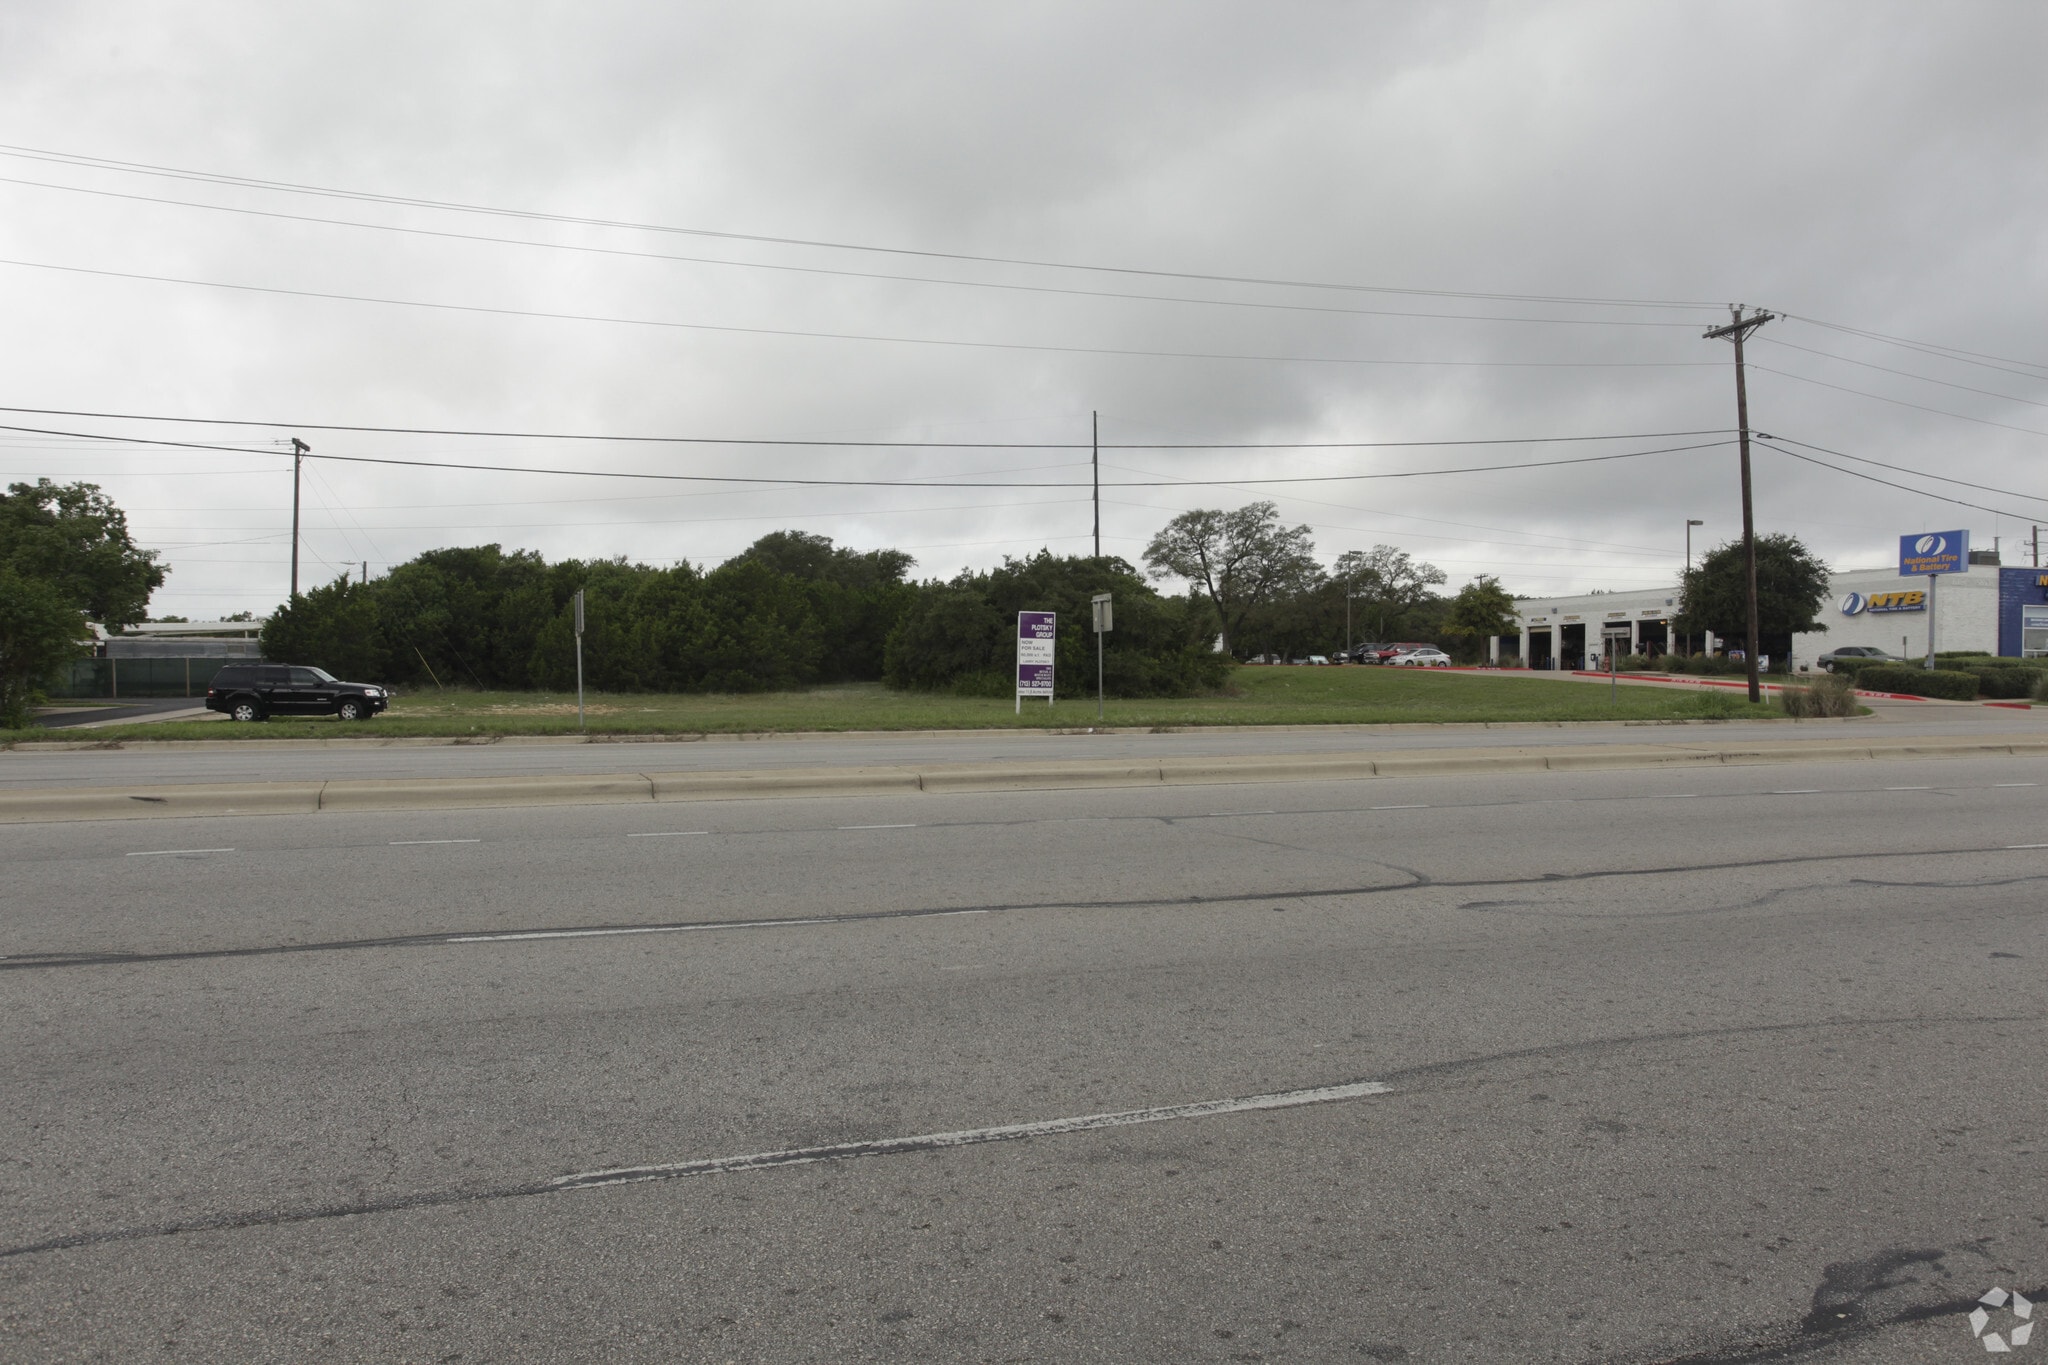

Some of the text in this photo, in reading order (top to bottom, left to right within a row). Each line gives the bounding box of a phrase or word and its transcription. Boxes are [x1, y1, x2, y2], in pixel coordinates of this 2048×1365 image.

[1904, 553, 1958, 565] National Tire
[1911, 562, 1951, 572] & Battery
[1868, 591, 1924, 606] NTB
